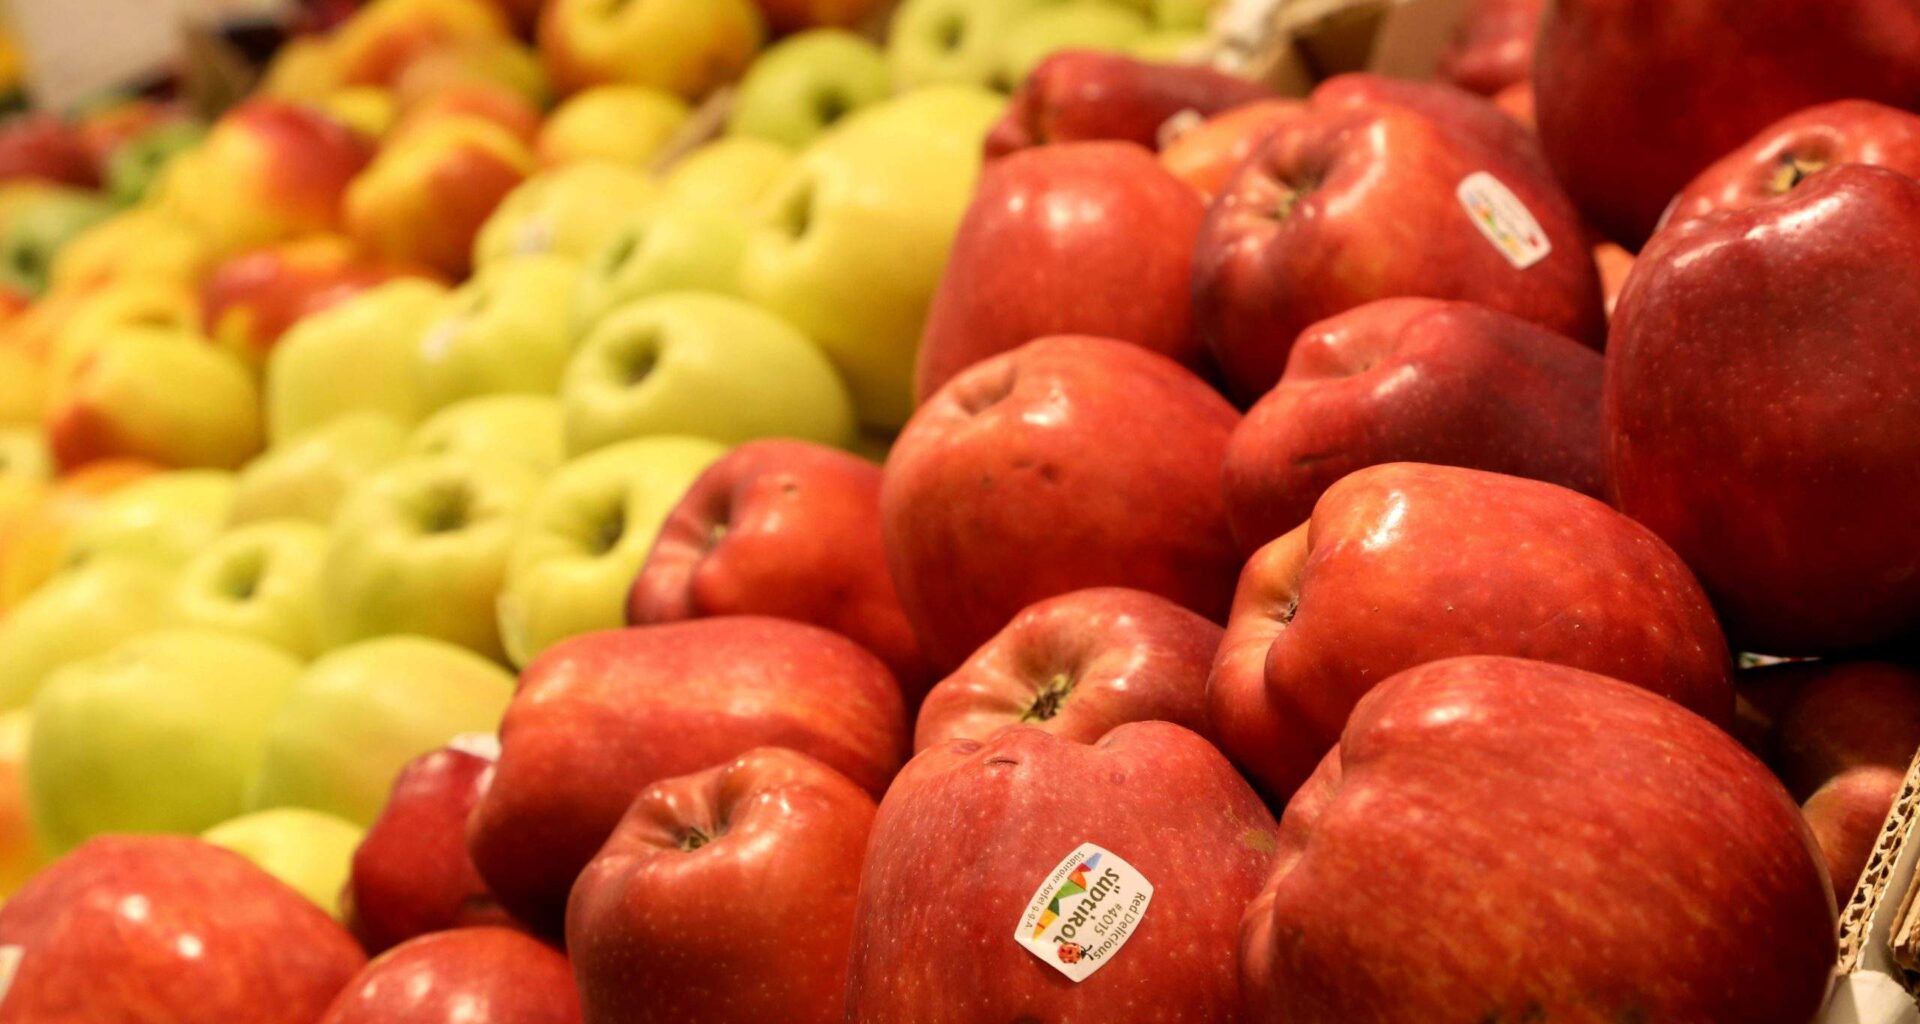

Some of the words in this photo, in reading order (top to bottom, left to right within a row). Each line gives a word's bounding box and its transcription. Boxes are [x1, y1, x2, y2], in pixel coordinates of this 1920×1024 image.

[1053, 851, 1085, 884] Südtiroler
[1094, 903, 1122, 936] #4015
[1129, 892, 1146, 916] Red
[1093, 914, 1135, 959] Delicious
